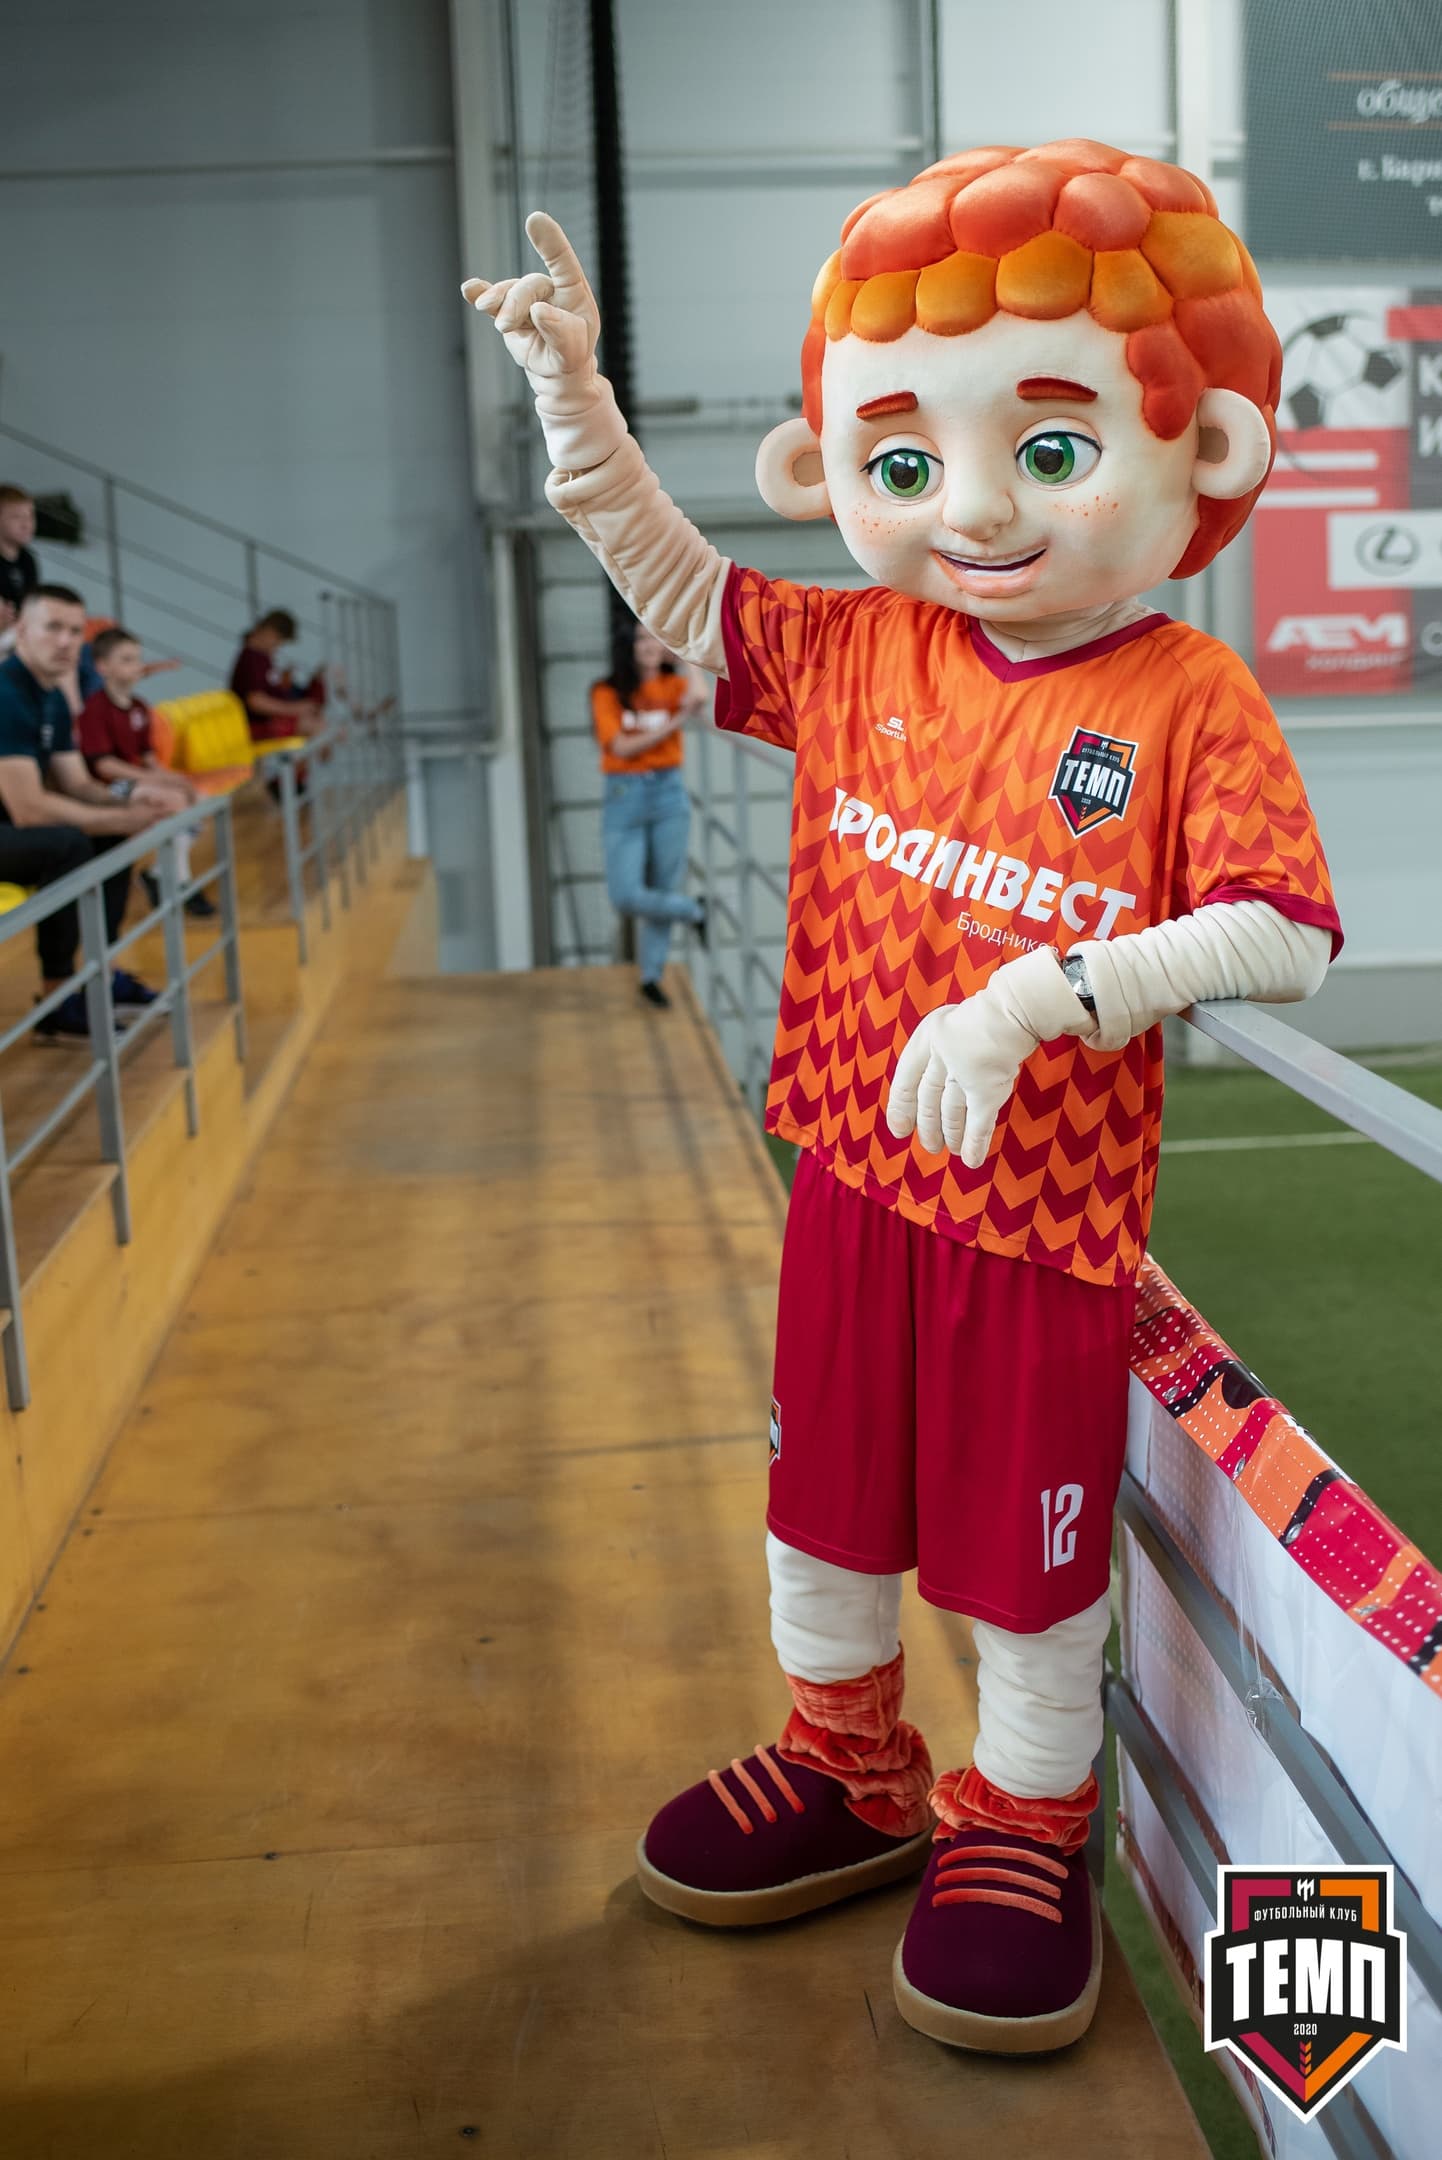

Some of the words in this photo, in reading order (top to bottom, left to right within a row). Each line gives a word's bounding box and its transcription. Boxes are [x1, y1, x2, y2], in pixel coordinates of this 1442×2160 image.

[1060, 759, 1127, 808] ТЕМП
[957, 911, 1060, 955] Бродник
[1041, 1483, 1084, 1574] 12
